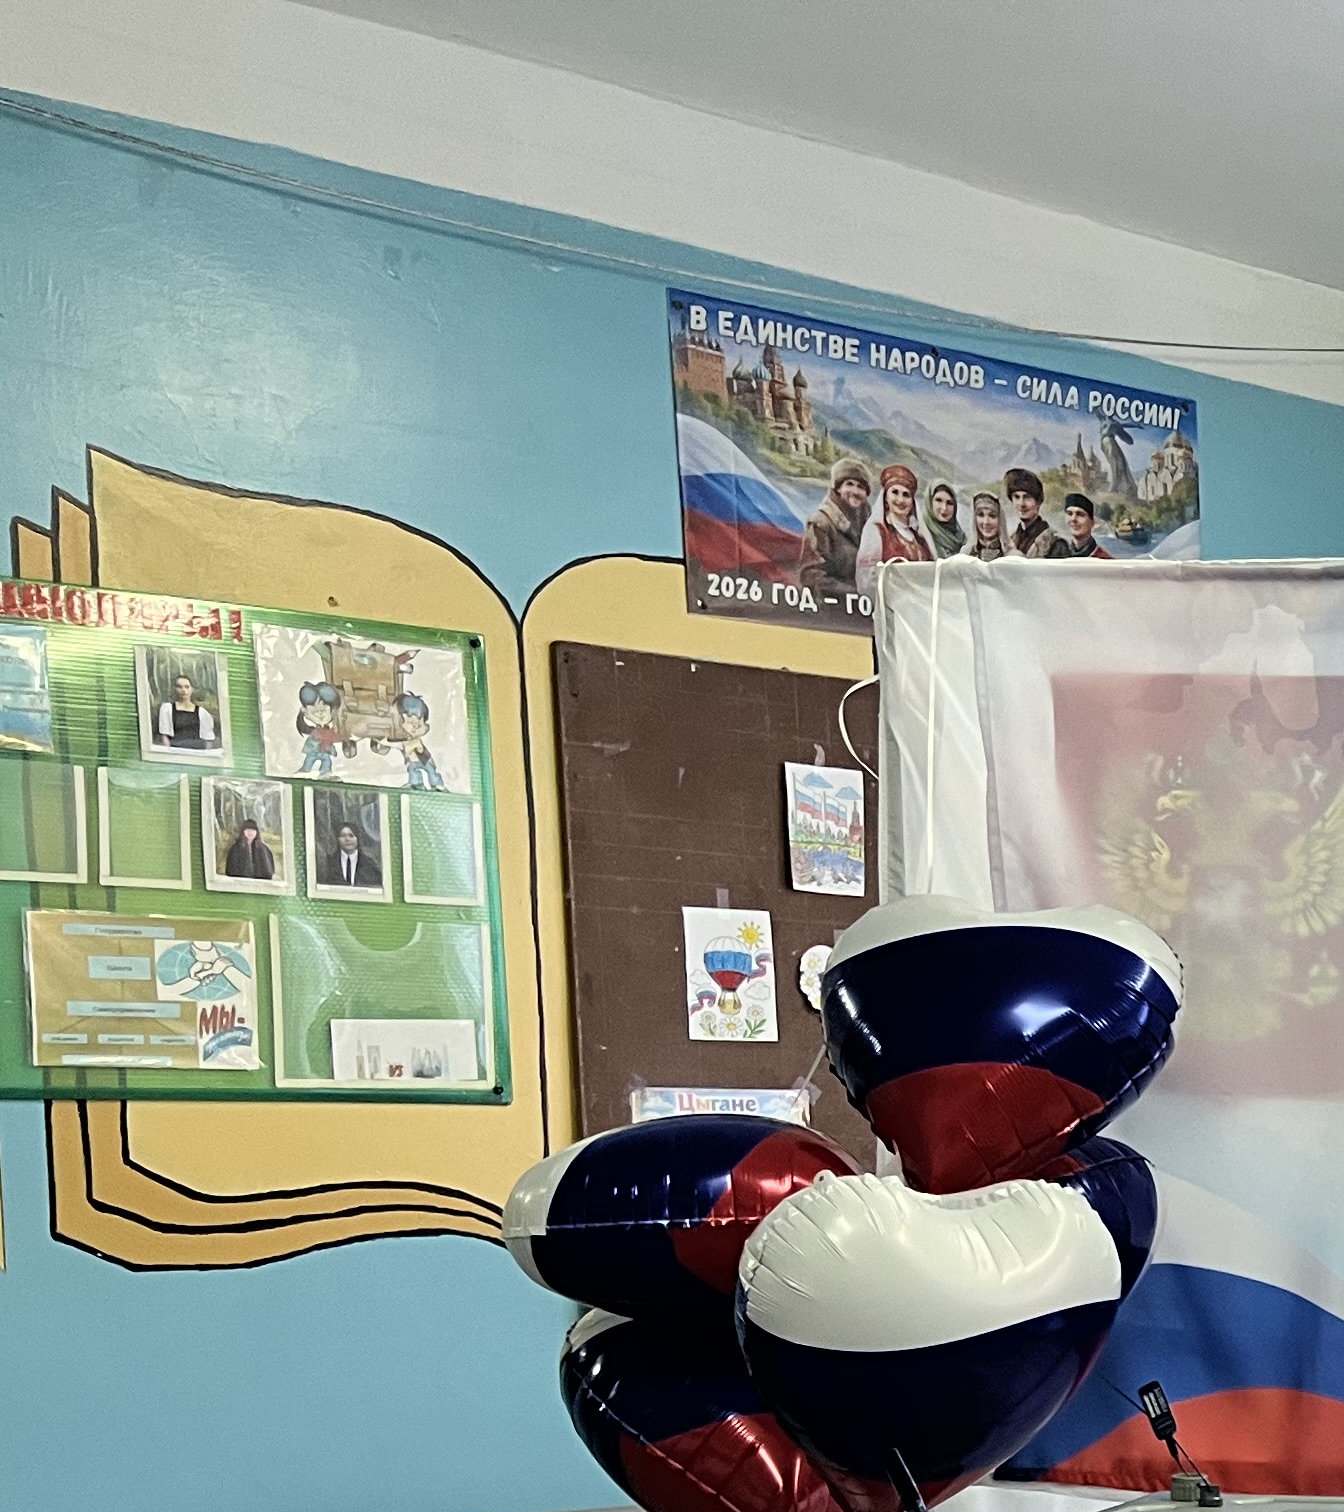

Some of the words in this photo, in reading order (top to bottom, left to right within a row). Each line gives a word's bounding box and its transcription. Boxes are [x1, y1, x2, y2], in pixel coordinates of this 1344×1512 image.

[689, 305, 707, 331] В
[718, 310, 860, 363] ЕДИНСТВЕ
[870, 343, 985, 389] НАРОДОВ
[1016, 375, 1080, 410] СИЛА
[1088, 391, 1180, 430] РОССИИ!
[707, 573, 763, 602] 2026
[771, 583, 818, 612] ГОД
[846, 593, 875, 617] ГО
[678, 1093, 757, 1113] Цыгане
